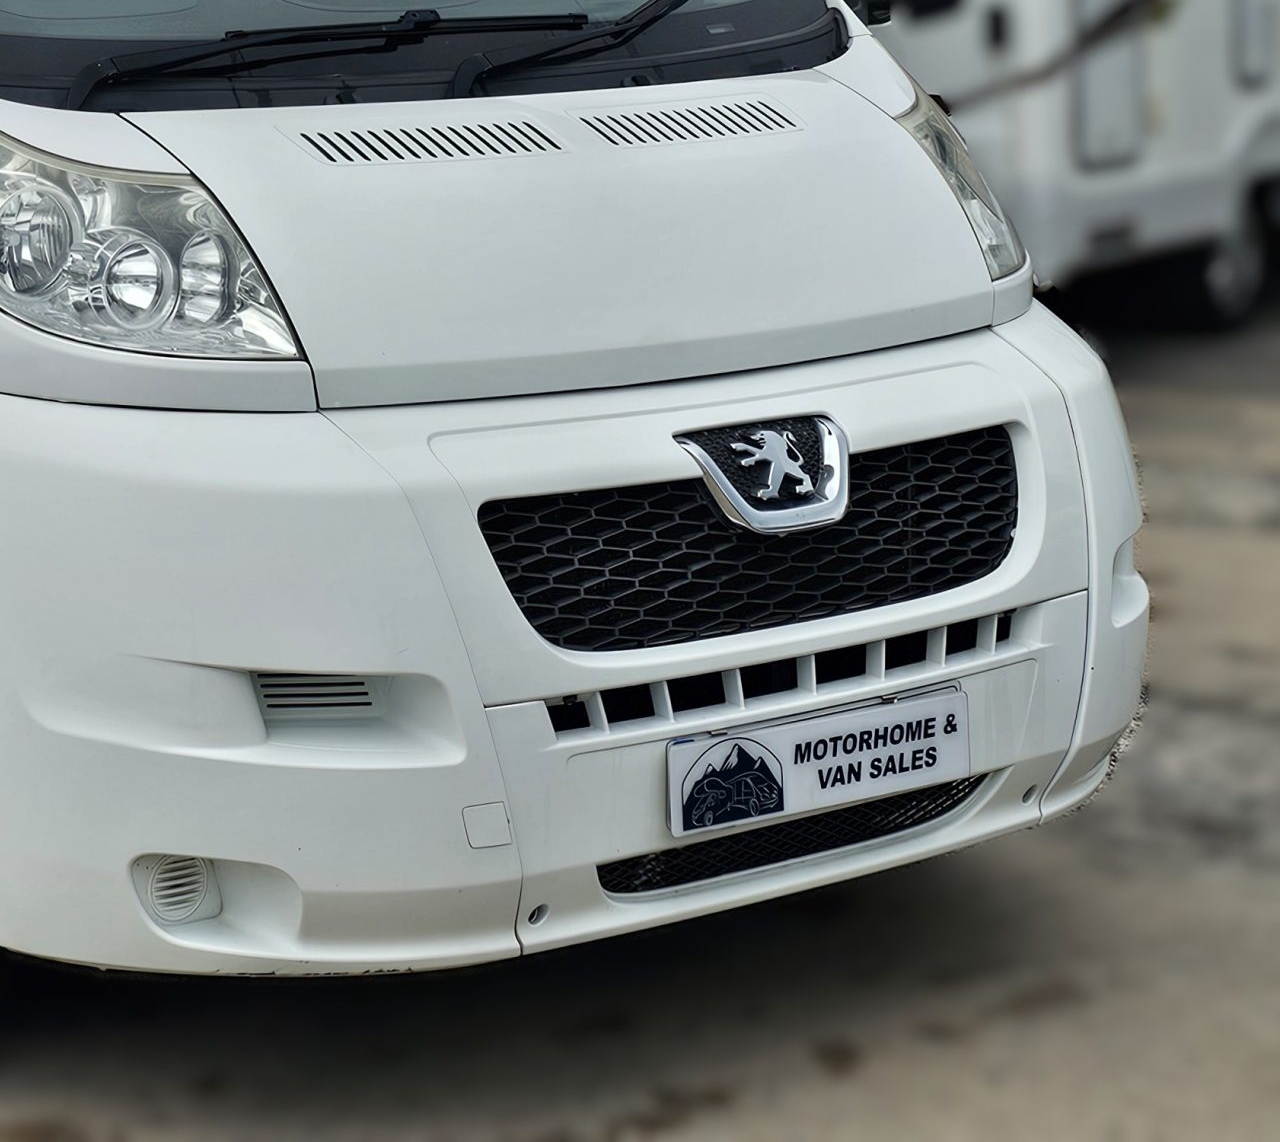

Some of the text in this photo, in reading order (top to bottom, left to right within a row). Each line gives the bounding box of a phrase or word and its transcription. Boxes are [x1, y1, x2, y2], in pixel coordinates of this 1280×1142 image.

[793, 713, 958, 765] MOTORHOME &
[818, 746, 937, 789] VAN SALES
